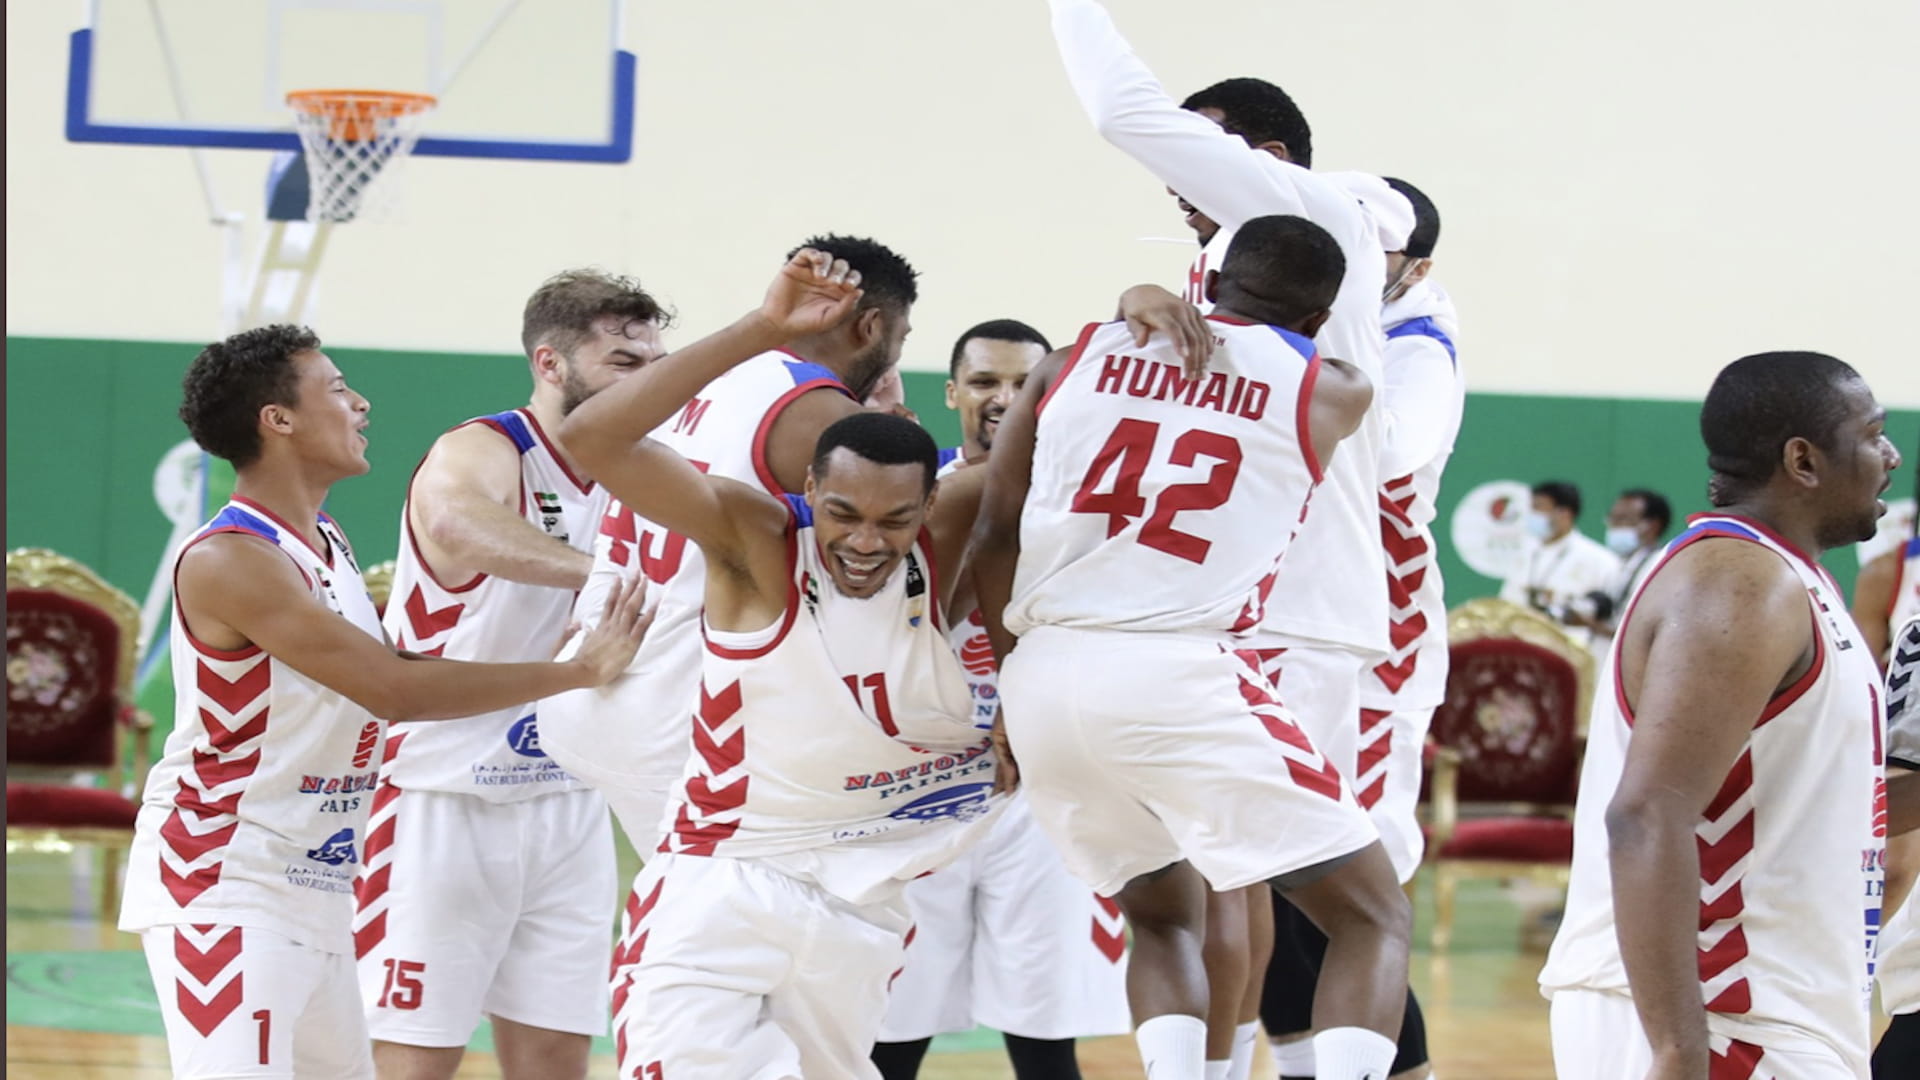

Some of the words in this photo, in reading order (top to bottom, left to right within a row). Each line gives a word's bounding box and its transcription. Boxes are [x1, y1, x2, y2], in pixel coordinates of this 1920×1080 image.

[1095, 354, 1271, 422] HUMAID
[1070, 417, 1243, 565] 42
[844, 737, 993, 790] NATIO
[880, 760, 992, 800] PAINTS
[377, 958, 426, 1011] 15
[252, 1009, 271, 1065] 1
